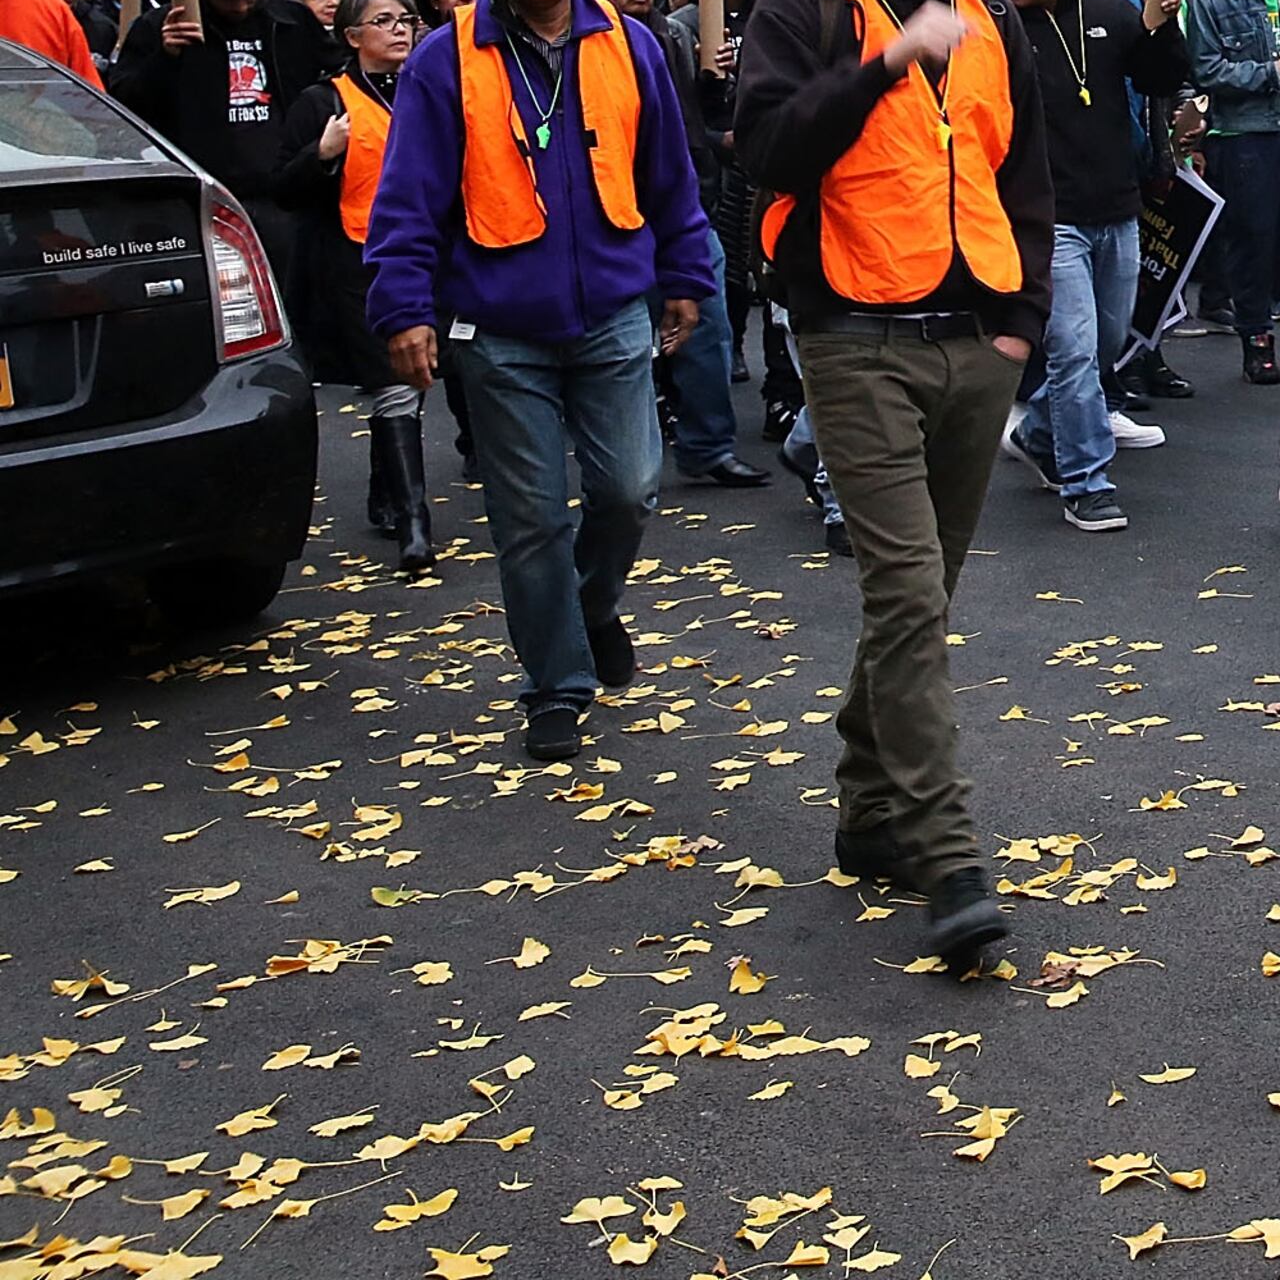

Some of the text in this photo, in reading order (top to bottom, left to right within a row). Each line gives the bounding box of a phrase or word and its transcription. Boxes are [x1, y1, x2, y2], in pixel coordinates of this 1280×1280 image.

[238, 108, 255, 122] FOR
[43, 234, 187, 265] build safe live safe
